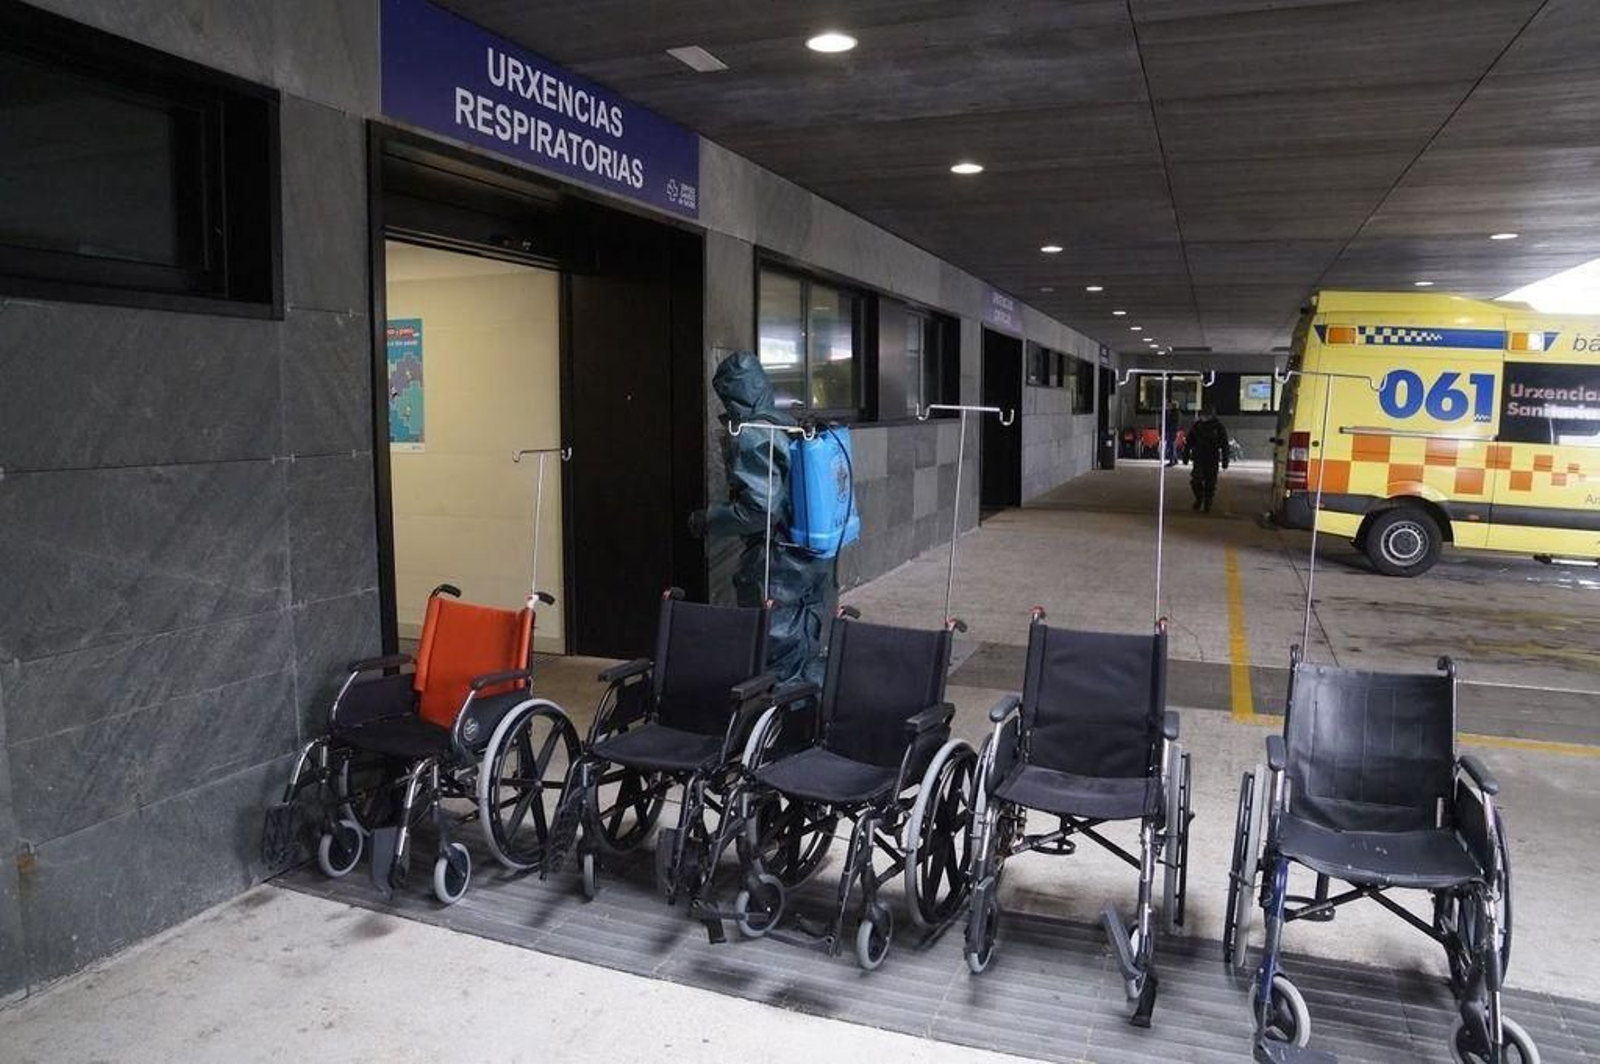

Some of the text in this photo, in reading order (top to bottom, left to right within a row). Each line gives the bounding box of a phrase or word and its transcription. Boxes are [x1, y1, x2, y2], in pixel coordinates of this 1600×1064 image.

[487, 47, 623, 138] URXENCIAS
[455, 86, 644, 189] RESPIRATORIAS
[1379, 369, 1494, 422] 061
[1510, 383, 1600, 402] Urxencia
